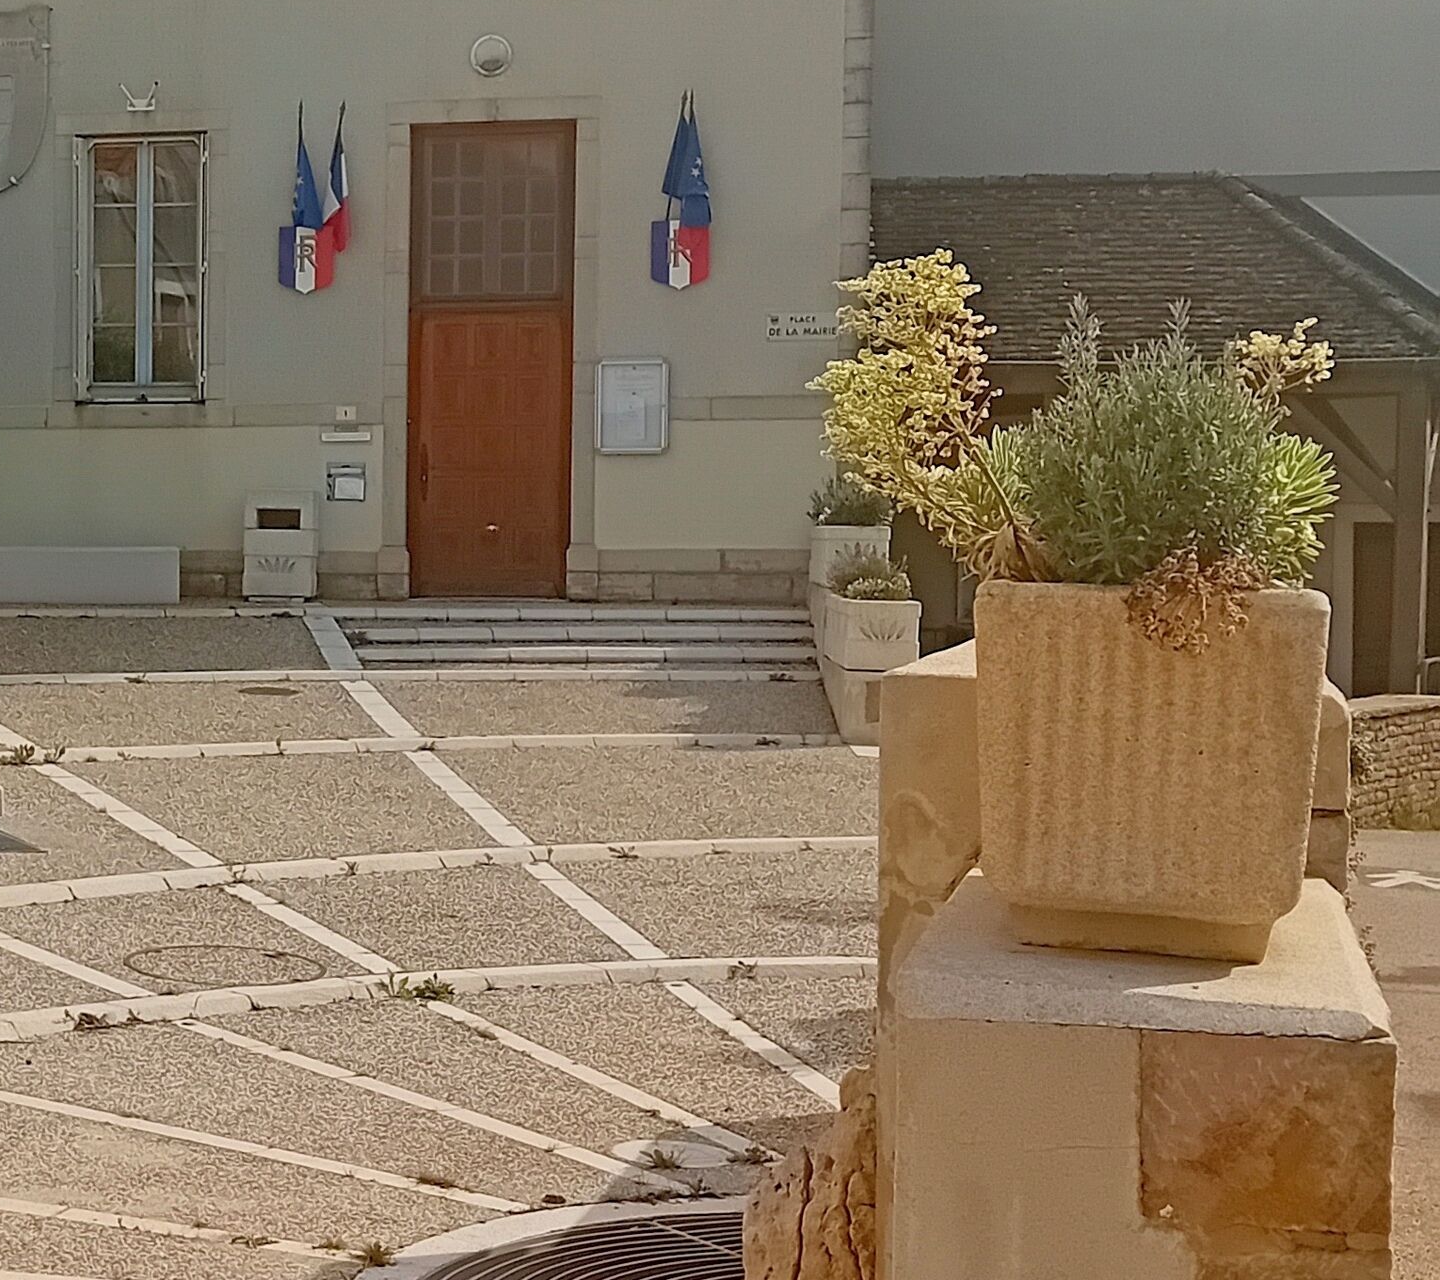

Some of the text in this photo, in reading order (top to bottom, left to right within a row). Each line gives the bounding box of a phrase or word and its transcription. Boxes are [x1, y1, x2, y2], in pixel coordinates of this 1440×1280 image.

[768, 326, 837, 336] DE LA MAIRIE
